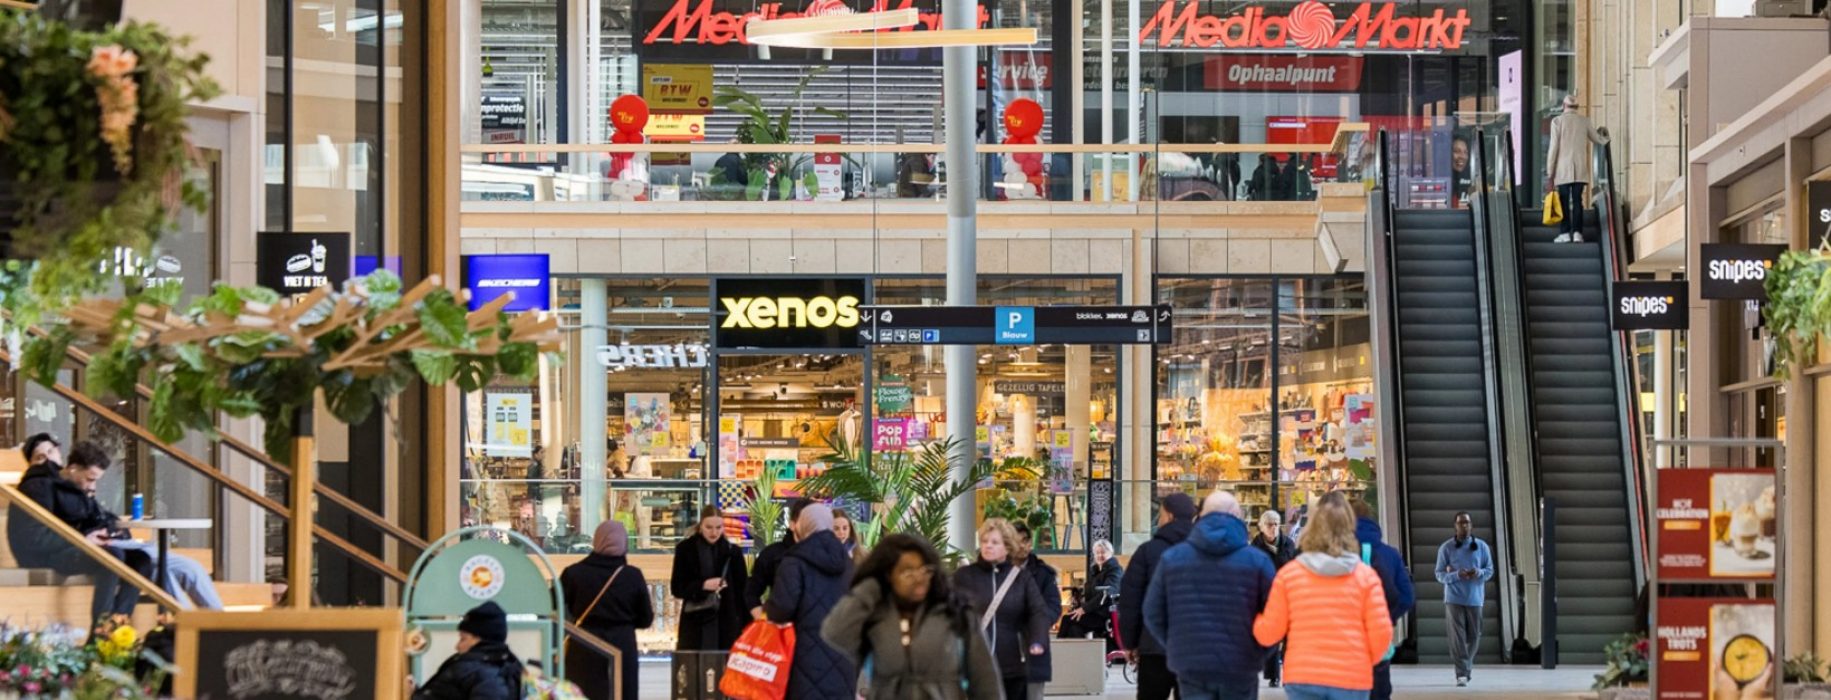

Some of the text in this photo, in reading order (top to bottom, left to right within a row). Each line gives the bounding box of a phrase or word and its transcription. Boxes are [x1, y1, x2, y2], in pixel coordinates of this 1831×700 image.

[1139, 0, 1471, 49] Media Markt
[1228, 63, 1337, 85] Ophaalpunt
[1709, 259, 1765, 283] snipes
[283, 275, 303, 288] VIET
[303, 275, 312, 288] N
[720, 296, 859, 329] xenos
[1620, 296, 1667, 317] snipes
[1009, 312, 1022, 329] P
[1002, 331, 1028, 339] Blauw
[996, 383, 1035, 393] GEZELLIG
[1657, 627, 1707, 639] HOLLANDS
